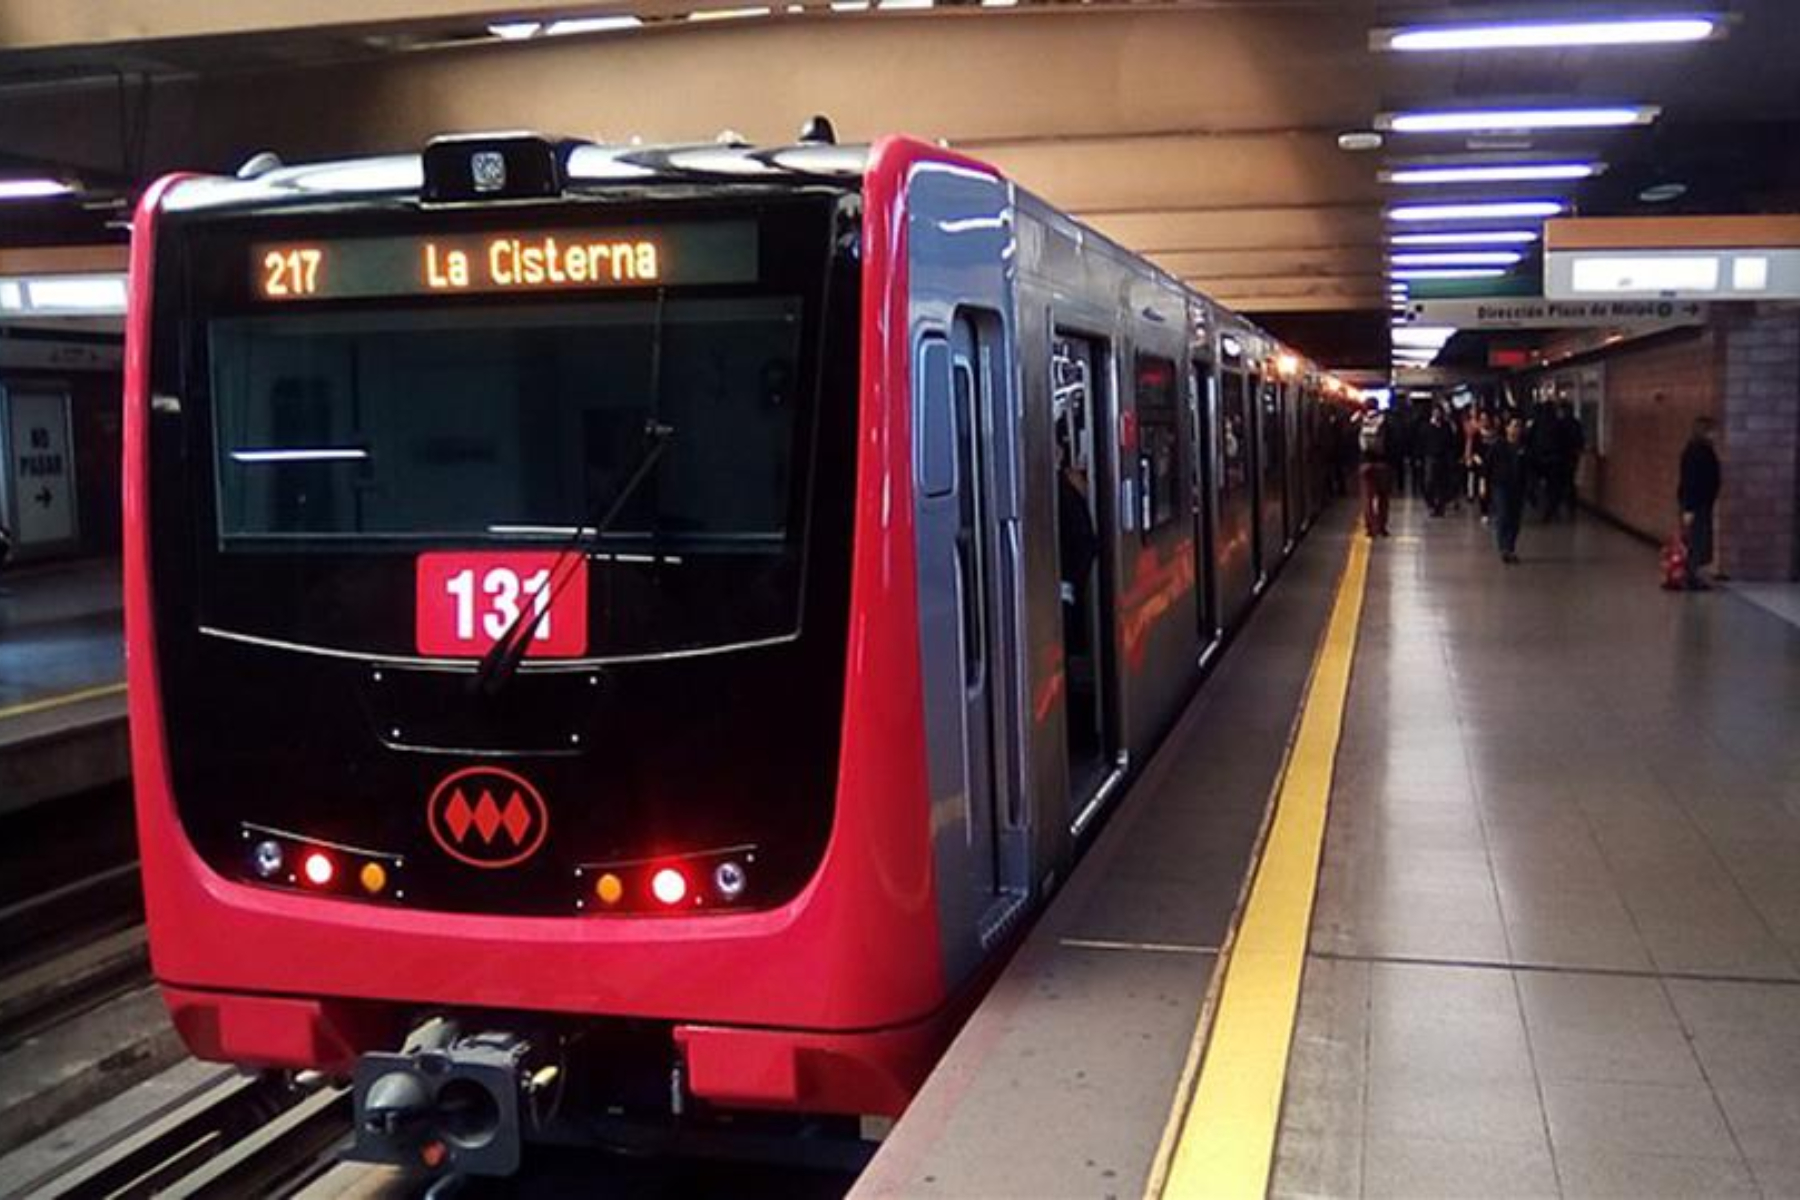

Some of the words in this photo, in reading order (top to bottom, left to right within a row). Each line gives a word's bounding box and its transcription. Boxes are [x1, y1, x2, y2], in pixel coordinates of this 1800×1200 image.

[265, 249, 321, 294] 217
[426, 243, 469, 287] La
[490, 237, 658, 284] Cisterna
[447, 567, 550, 640] 131
